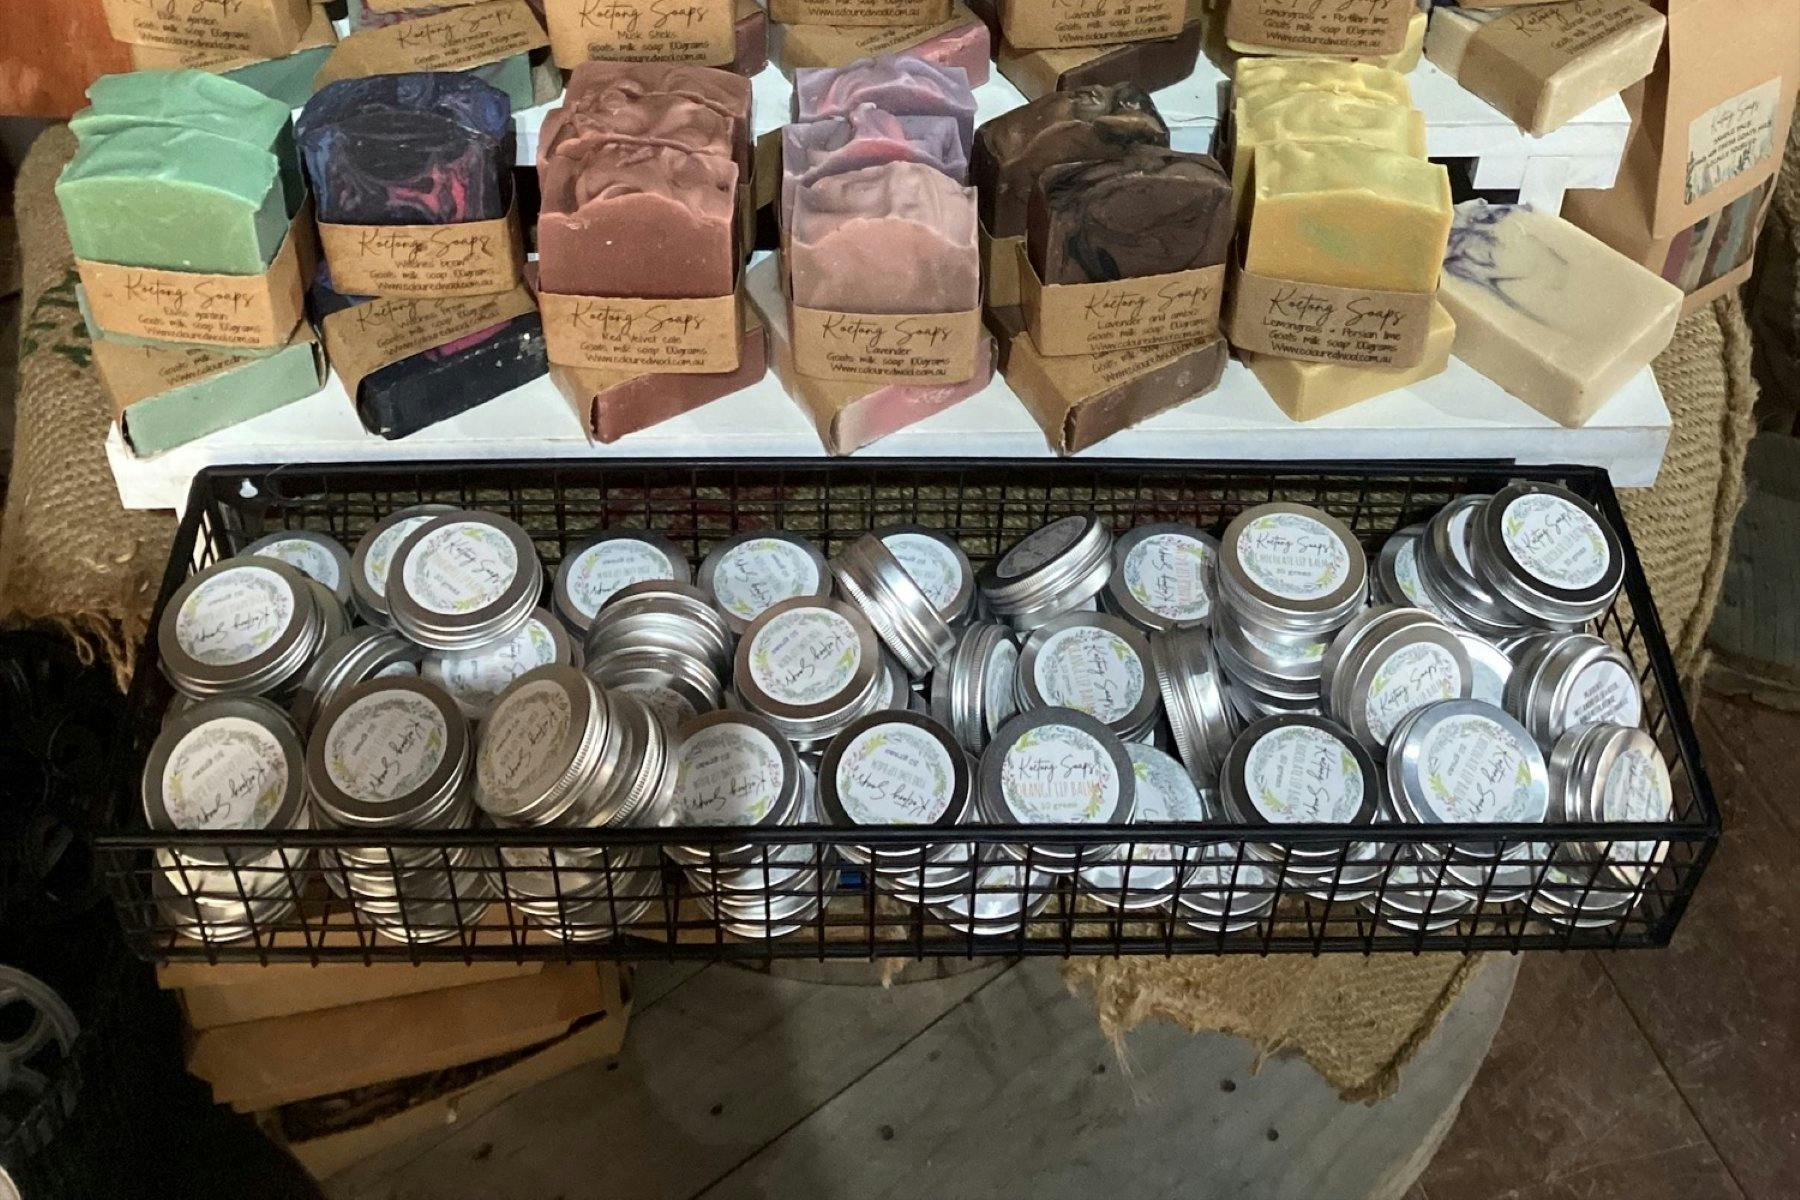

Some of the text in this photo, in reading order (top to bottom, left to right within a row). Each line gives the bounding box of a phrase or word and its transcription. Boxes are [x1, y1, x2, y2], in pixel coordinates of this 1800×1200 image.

[579, 0, 643, 30] Koetong
[618, 31, 641, 39] Musk
[588, 42, 614, 52] Goats
[358, 228, 424, 262] Koetong
[125, 270, 255, 312] Koetong Soaps
[1084, 281, 1213, 319] Koetong Soaps
[1269, 288, 1407, 325] Koetong Soaps
[571, 301, 705, 337] Koetong Soaps
[1098, 319, 1141, 329] Lavender
[1149, 313, 1165, 322] and
[1263, 317, 1322, 333] Lemongrass
[1342, 328, 1376, 339] Persian
[822, 315, 952, 347] Koetong Soaps
[1269, 330, 1297, 342] Goats
[1303, 336, 1319, 345] milk
[1327, 339, 1350, 349] soap
[580, 343, 608, 352] Goats
[866, 346, 911, 355] Lavender
[826, 353, 854, 362] Goats
[883, 358, 905, 366] soap
